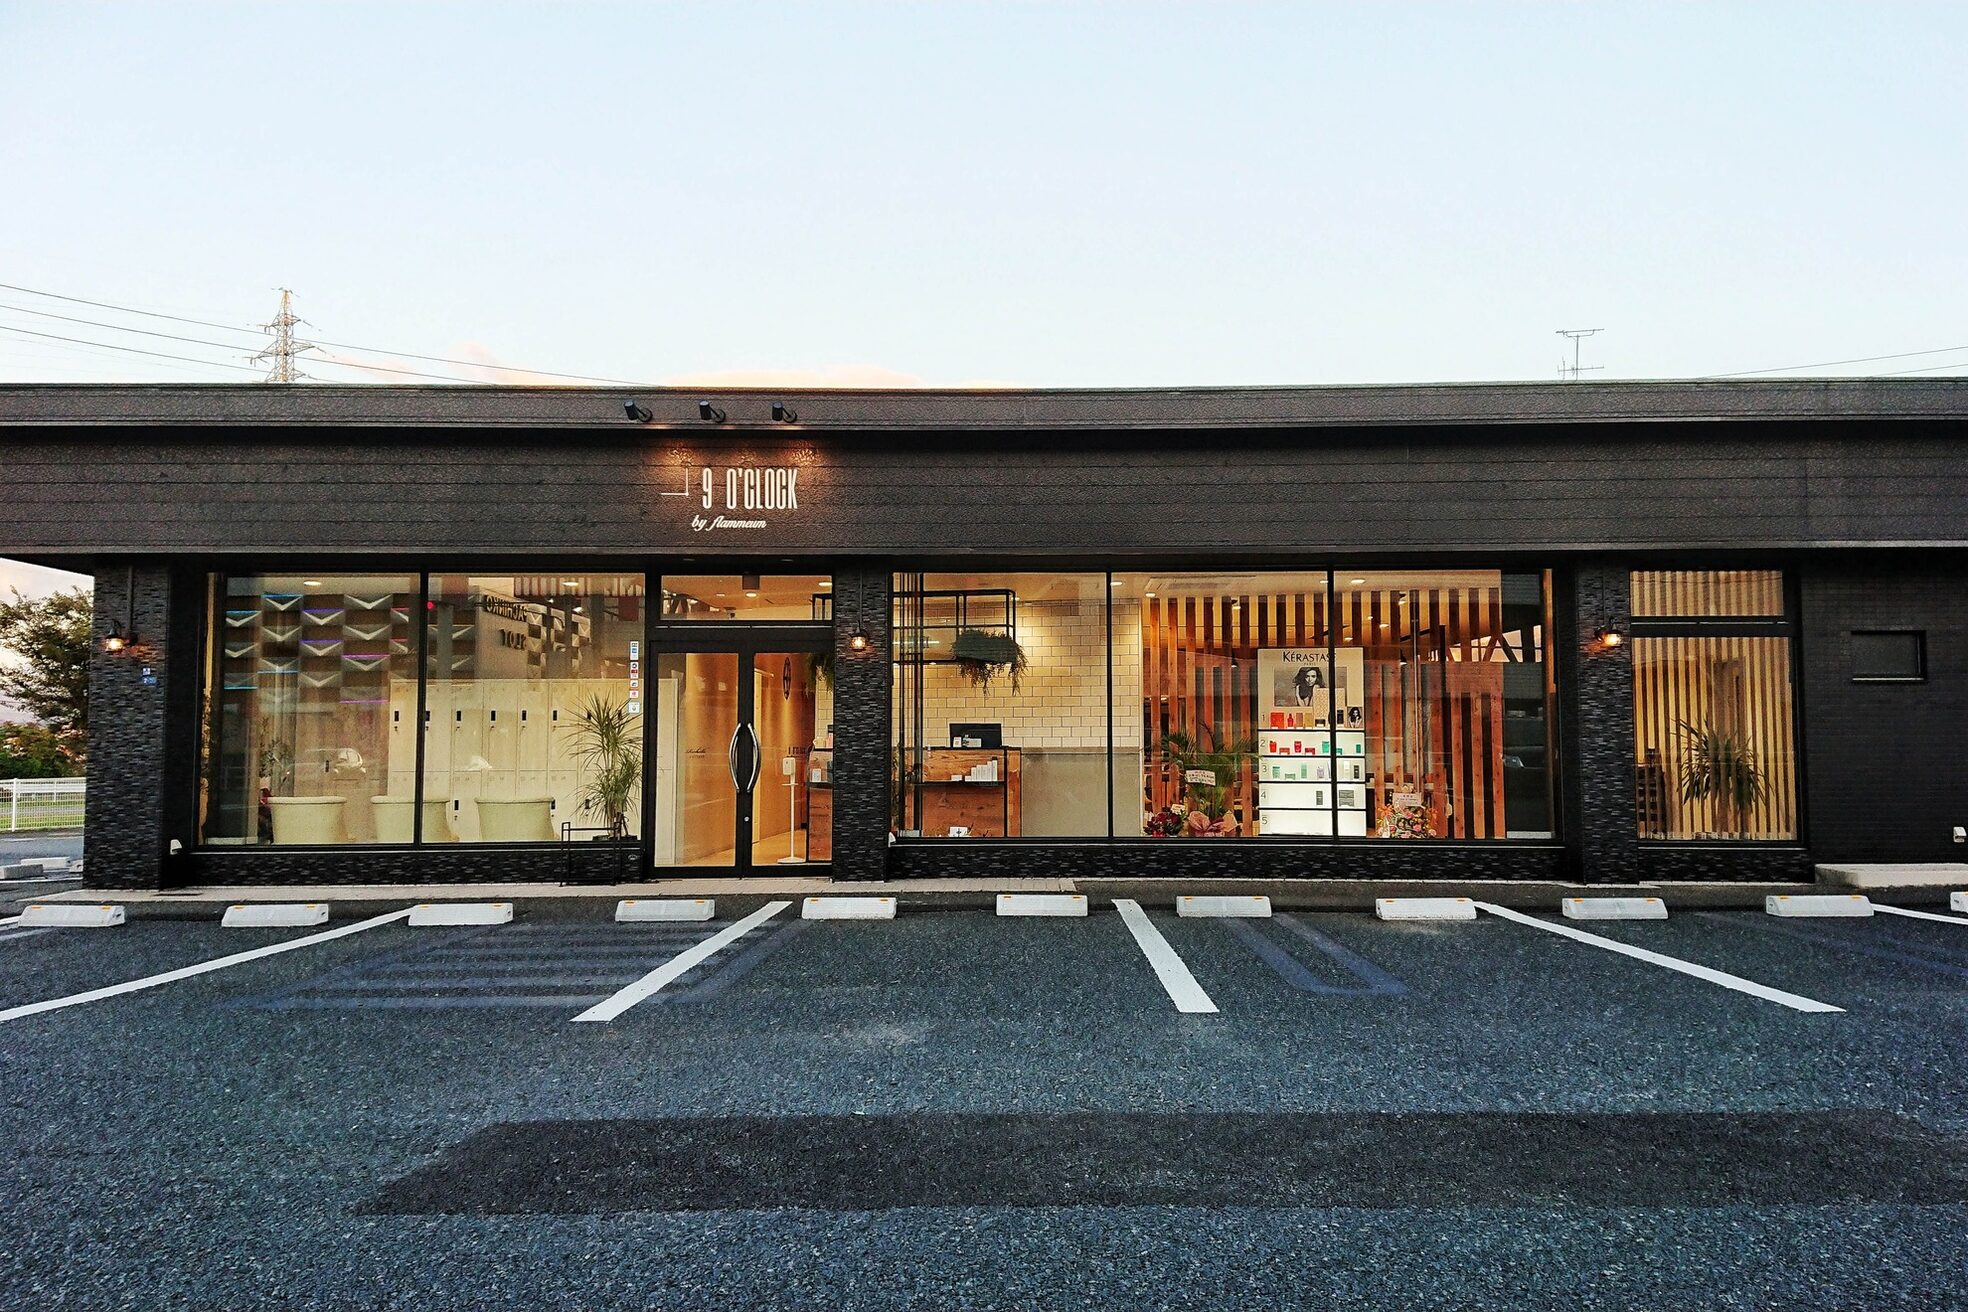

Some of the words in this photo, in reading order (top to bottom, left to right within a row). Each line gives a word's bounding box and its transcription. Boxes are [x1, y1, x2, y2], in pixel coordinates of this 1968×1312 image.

[702, 468, 713, 509] 9
[726, 468, 798, 509] O'CLOCK
[691, 514, 707, 531] by
[1260, 739, 1266, 747] 2
[1262, 764, 1267, 772] 3
[1261, 790, 1267, 798] 4
[1262, 816, 1268, 824] 5
